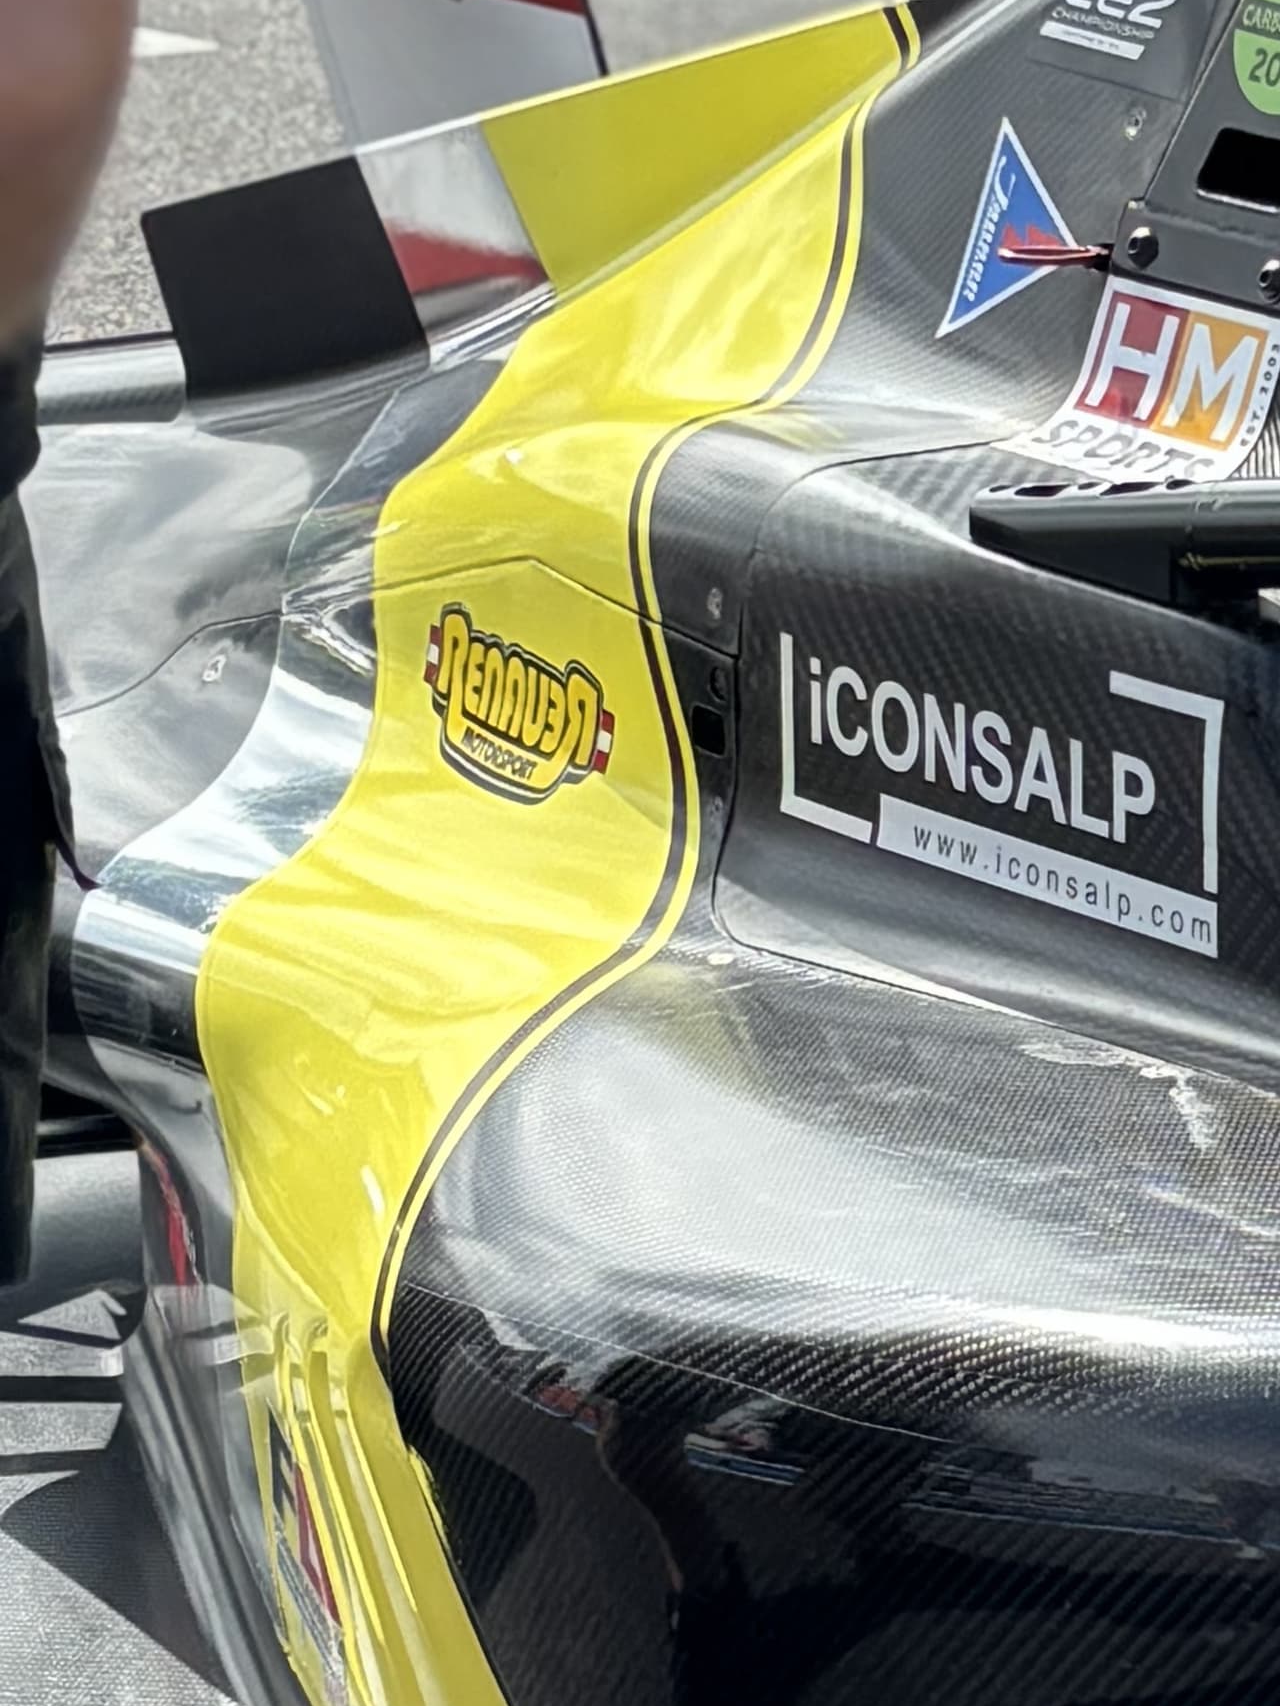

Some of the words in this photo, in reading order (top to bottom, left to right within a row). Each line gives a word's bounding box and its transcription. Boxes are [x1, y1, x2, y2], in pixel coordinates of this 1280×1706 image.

[1085, 302, 1260, 443] HM
[460, 726, 538, 780] MOTORSPORT
[912, 823, 1214, 945] www.iconsalp.com
